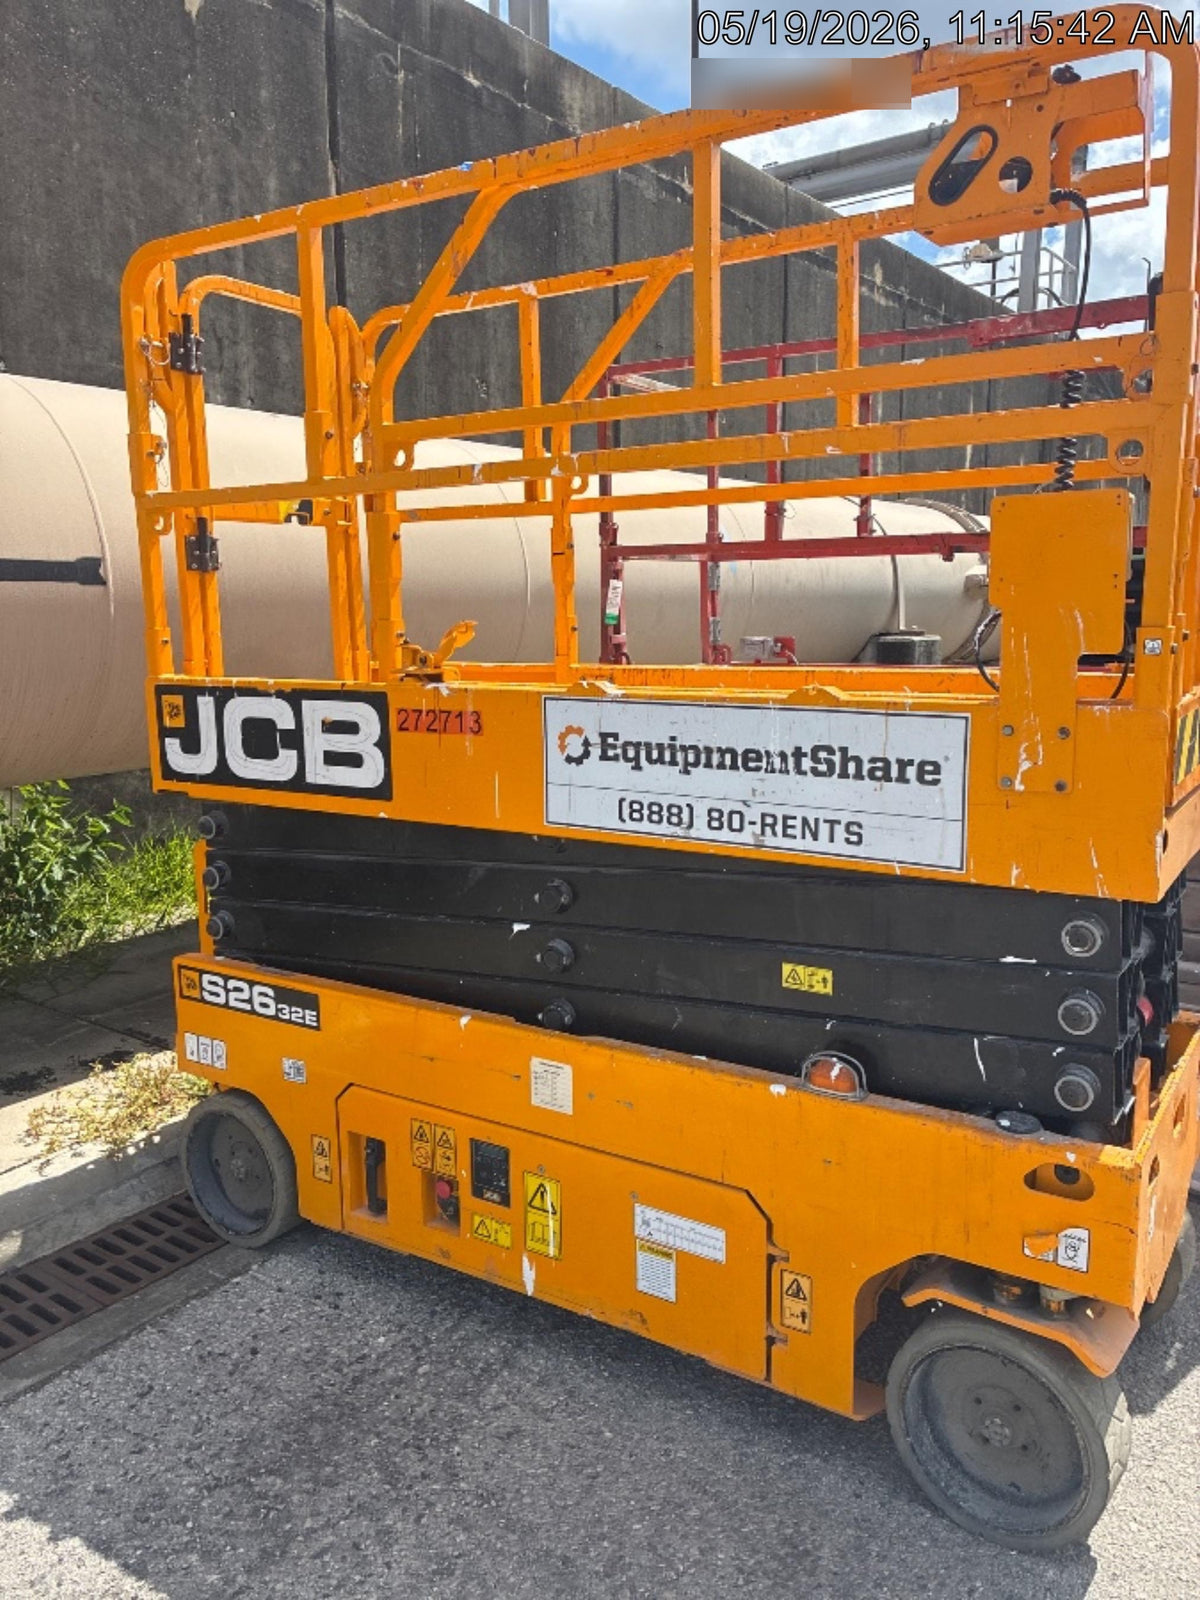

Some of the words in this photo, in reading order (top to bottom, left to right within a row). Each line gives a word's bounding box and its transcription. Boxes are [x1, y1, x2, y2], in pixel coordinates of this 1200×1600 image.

[164, 696, 385, 788] JCB
[397, 708, 482, 734] 272713
[599, 731, 942, 786] EquipmentShare
[617, 798, 695, 829] (888)
[706, 807, 864, 847] 80-RENTS
